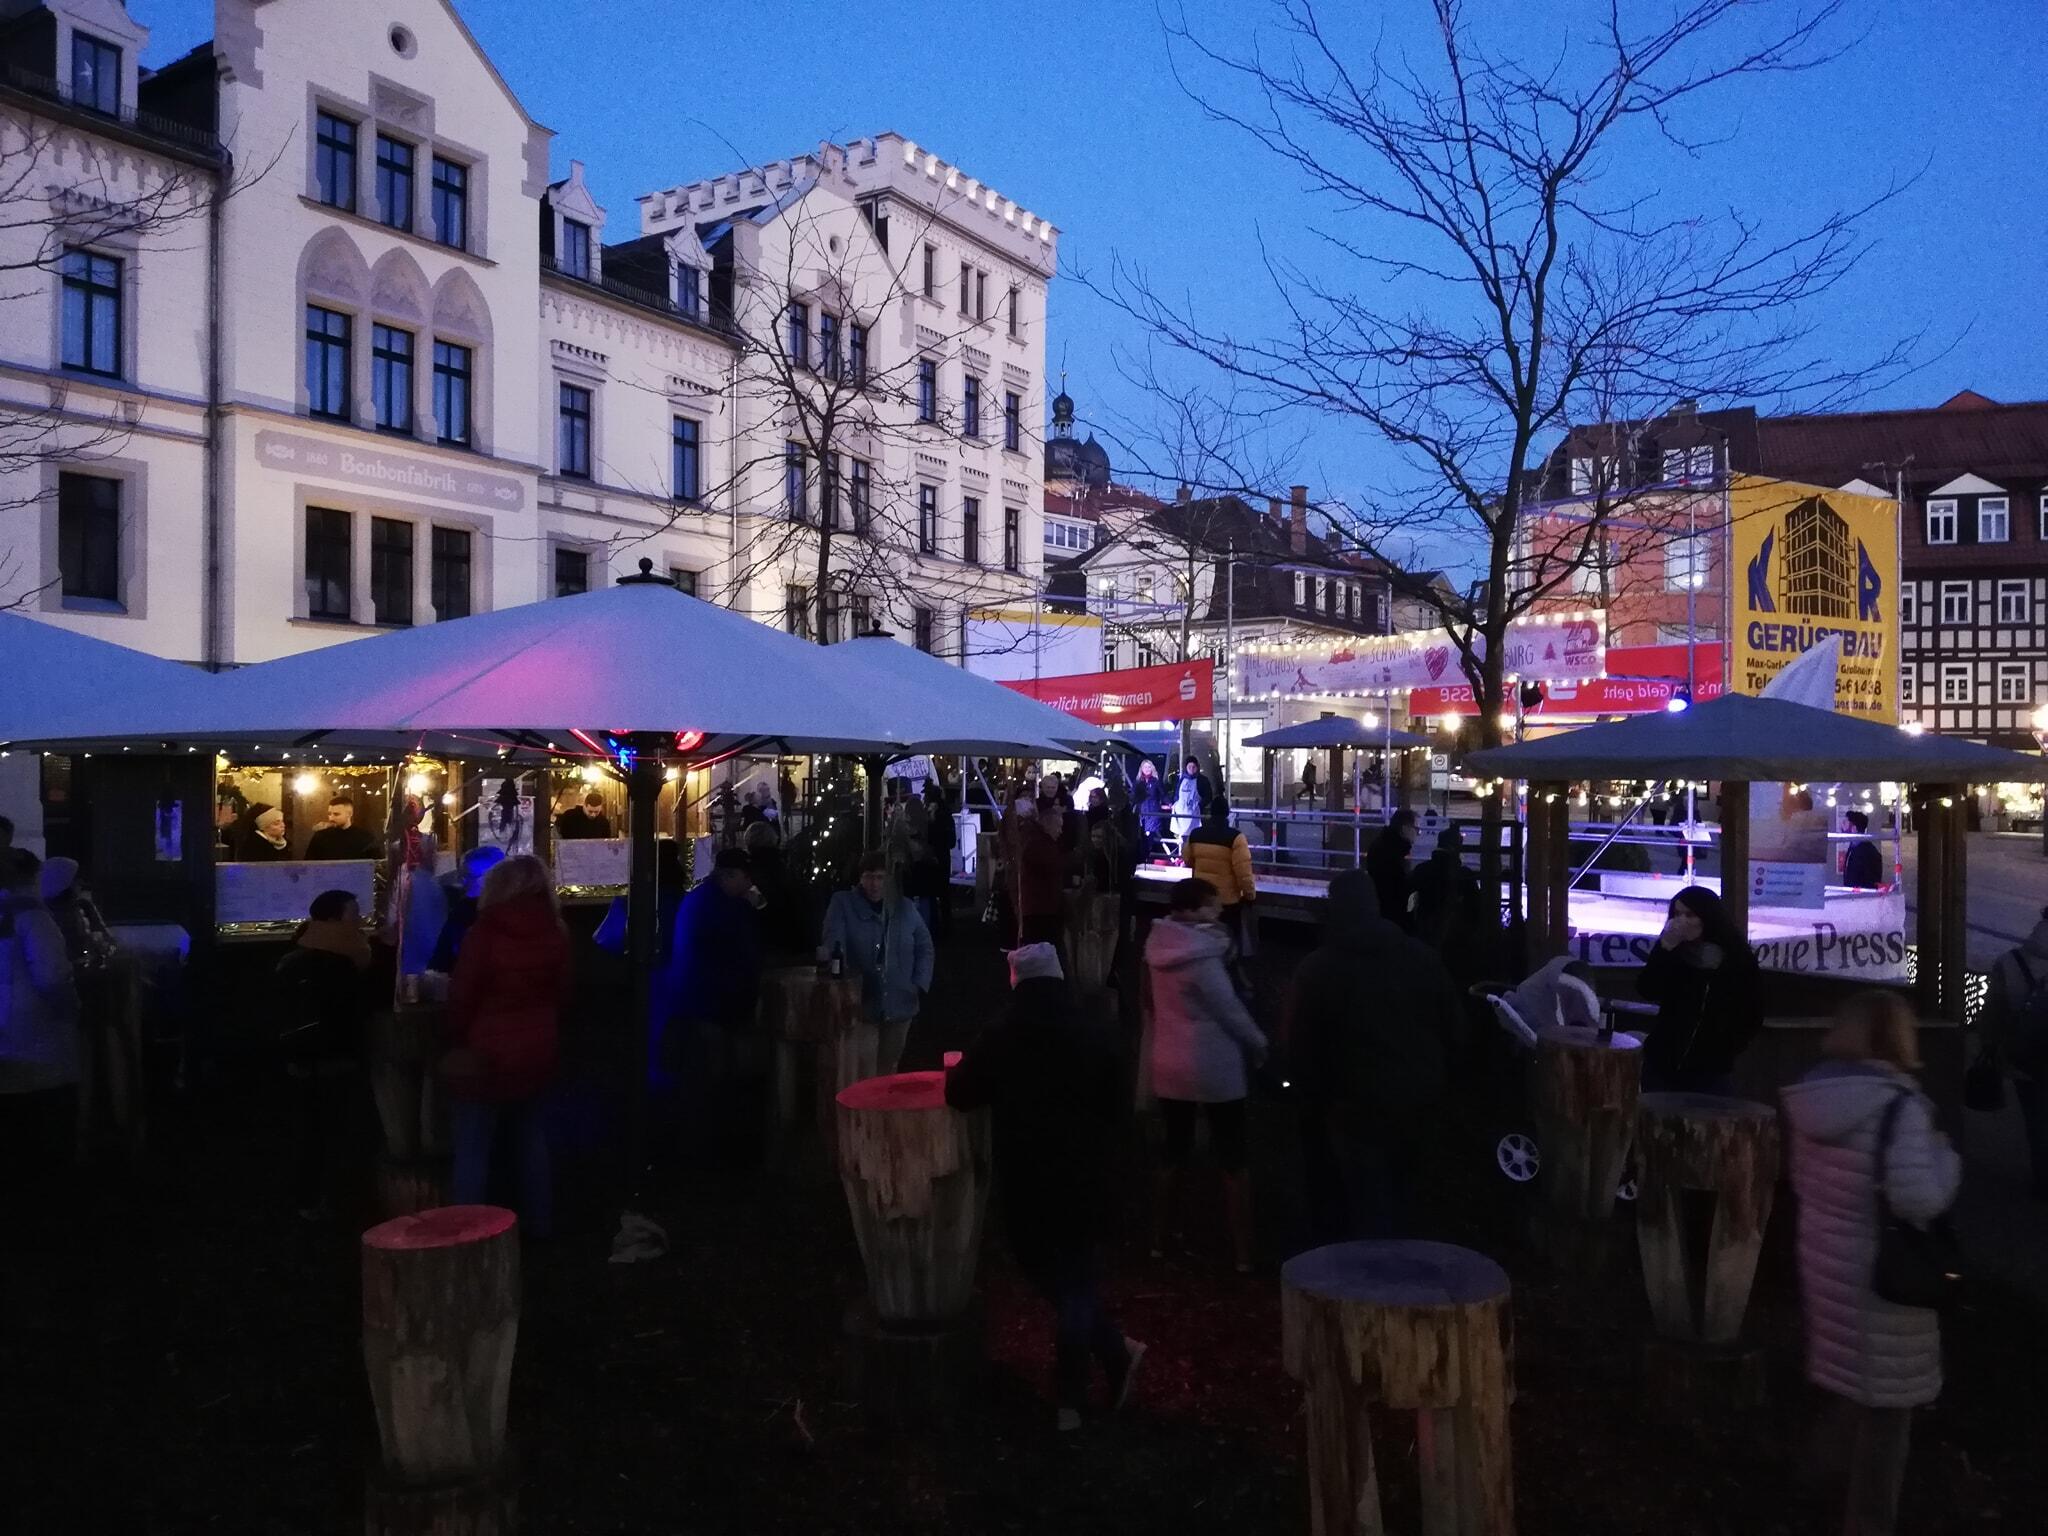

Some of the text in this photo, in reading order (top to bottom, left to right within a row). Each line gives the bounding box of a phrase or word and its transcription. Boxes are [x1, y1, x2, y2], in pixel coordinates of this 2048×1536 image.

[340, 452, 457, 492] Bonbonfabrik
[1505, 643, 1534, 670] BURG
[1565, 655, 1597, 666] WSCO
[1753, 922, 1904, 974] eue Press
